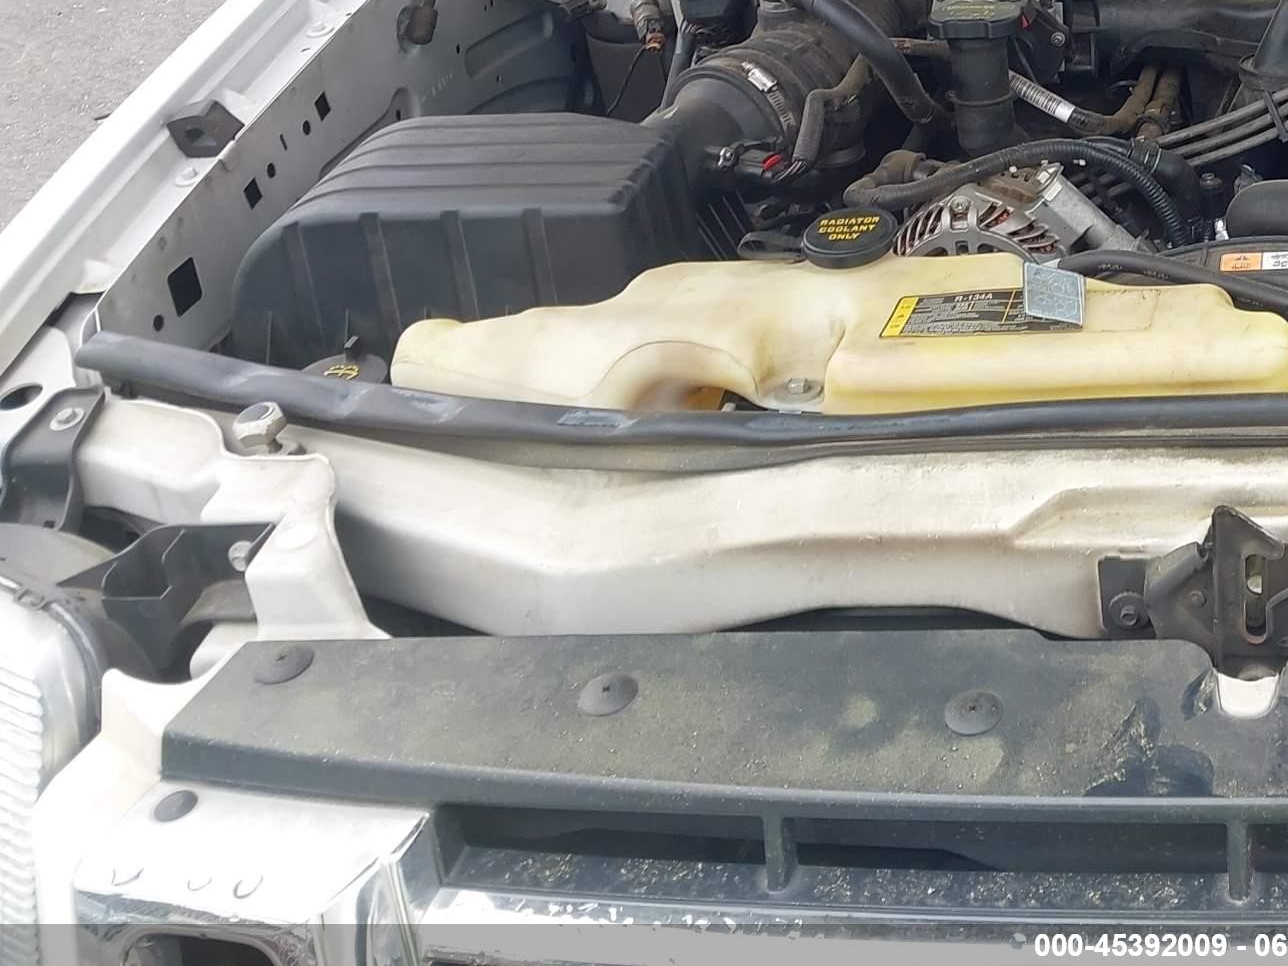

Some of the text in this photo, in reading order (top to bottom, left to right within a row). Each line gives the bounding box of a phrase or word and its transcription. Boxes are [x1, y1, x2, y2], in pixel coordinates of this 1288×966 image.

[820, 216, 880, 226] RADIATOR
[818, 224, 877, 234] COOLANT
[828, 233, 860, 241] ONLY
[954, 293, 993, 302] R-134A
